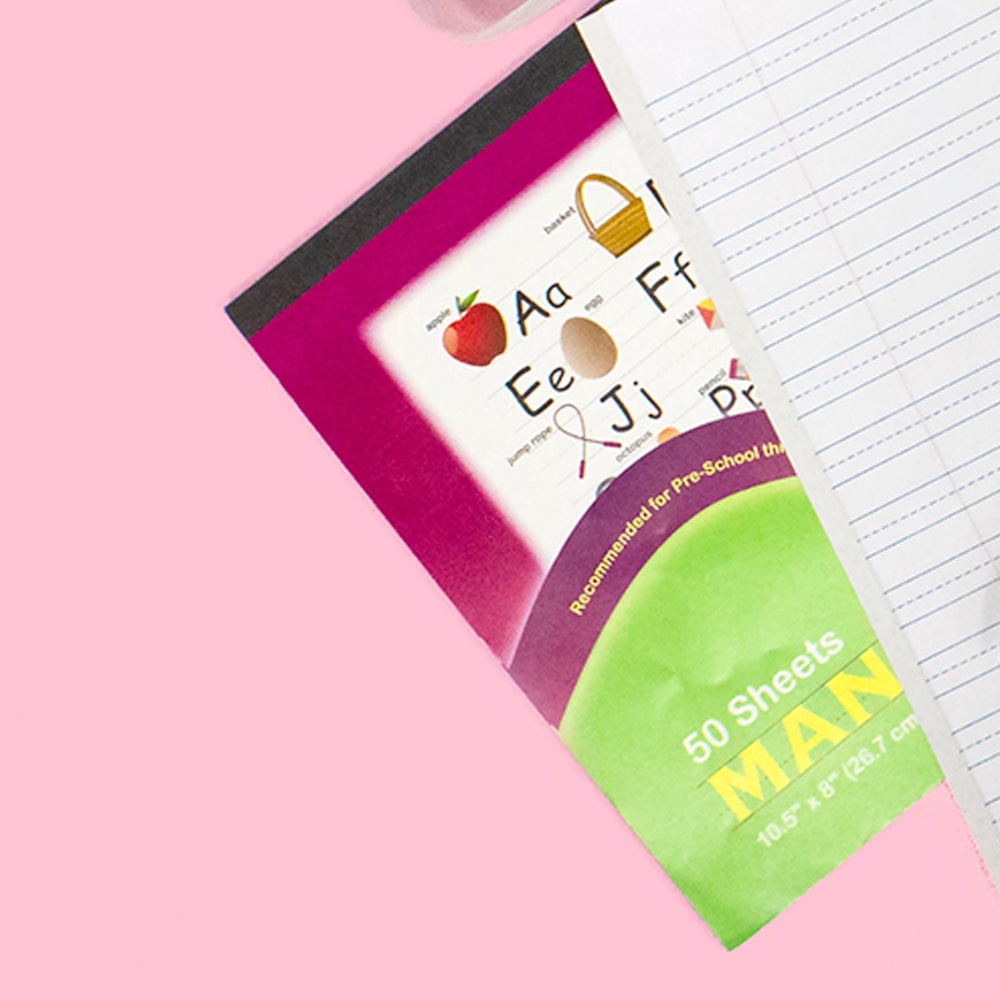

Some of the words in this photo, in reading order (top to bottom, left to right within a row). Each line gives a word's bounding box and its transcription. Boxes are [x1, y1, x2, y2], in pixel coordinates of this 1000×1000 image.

[543, 206, 577, 235] basket
[584, 295, 604, 313] egg
[635, 251, 697, 313] Ff
[425, 307, 452, 332] apple
[515, 282, 573, 337] Aa
[676, 308, 695, 326] kite
[505, 366, 575, 417] Ee
[600, 380, 663, 432] Jj
[507, 440, 532, 467] jump
[531, 425, 553, 447] rope
[616, 431, 653, 463] octopus
[569, 506, 653, 616] Recommended
[647, 488, 672, 511] for
[671, 447, 760, 493] Pre-School
[682, 718, 730, 763] 50
[728, 630, 845, 727] Sheets
[708, 647, 903, 824] MAN
[806, 797, 821, 811] x
[842, 735, 888, 782] (26.7
